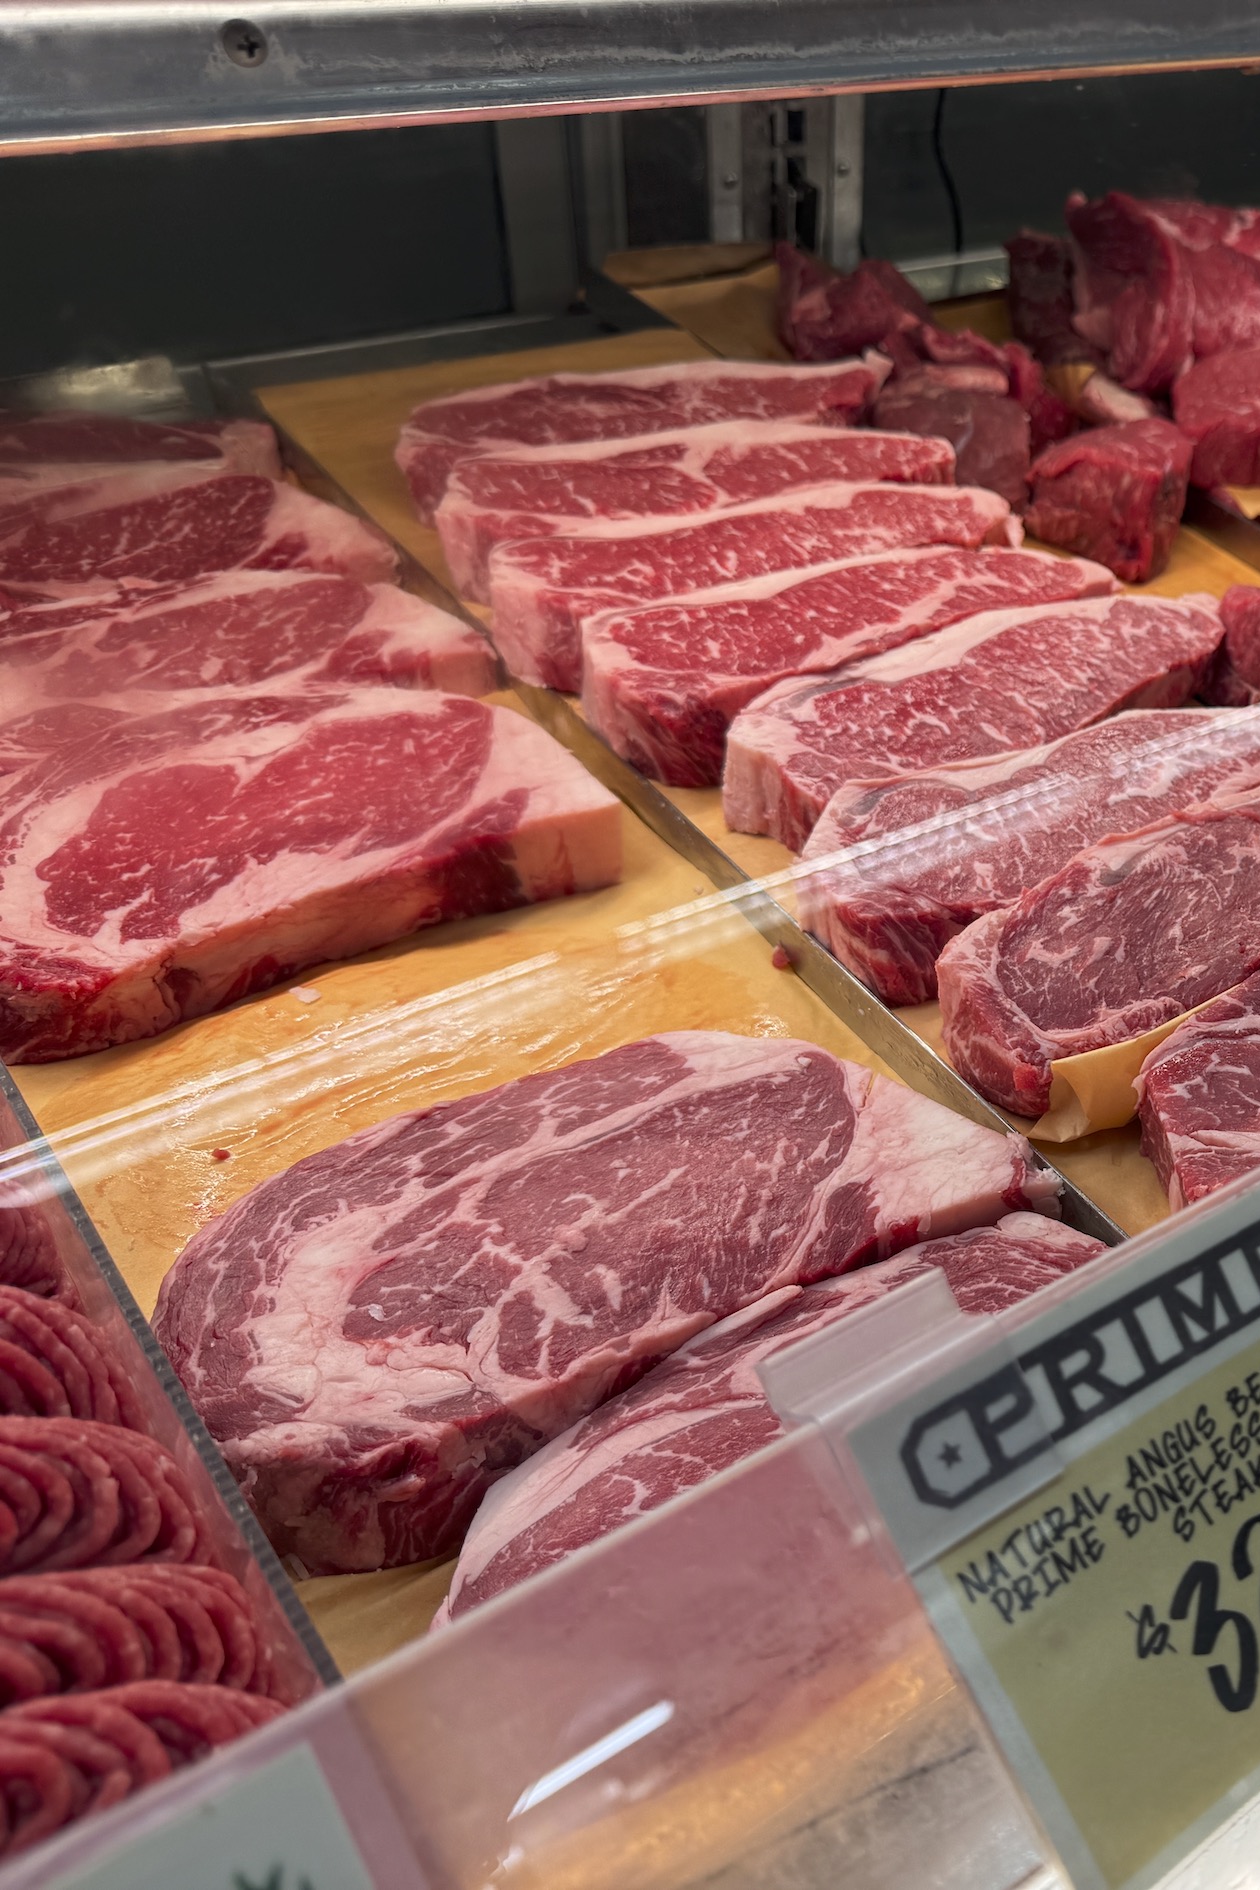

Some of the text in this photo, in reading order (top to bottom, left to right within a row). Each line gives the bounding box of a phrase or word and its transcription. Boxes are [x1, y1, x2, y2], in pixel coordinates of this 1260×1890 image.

[956, 1484, 1112, 1604] NATURAL
[1124, 1403, 1218, 1491] ANGUS
[989, 1525, 1107, 1626] PRIME
